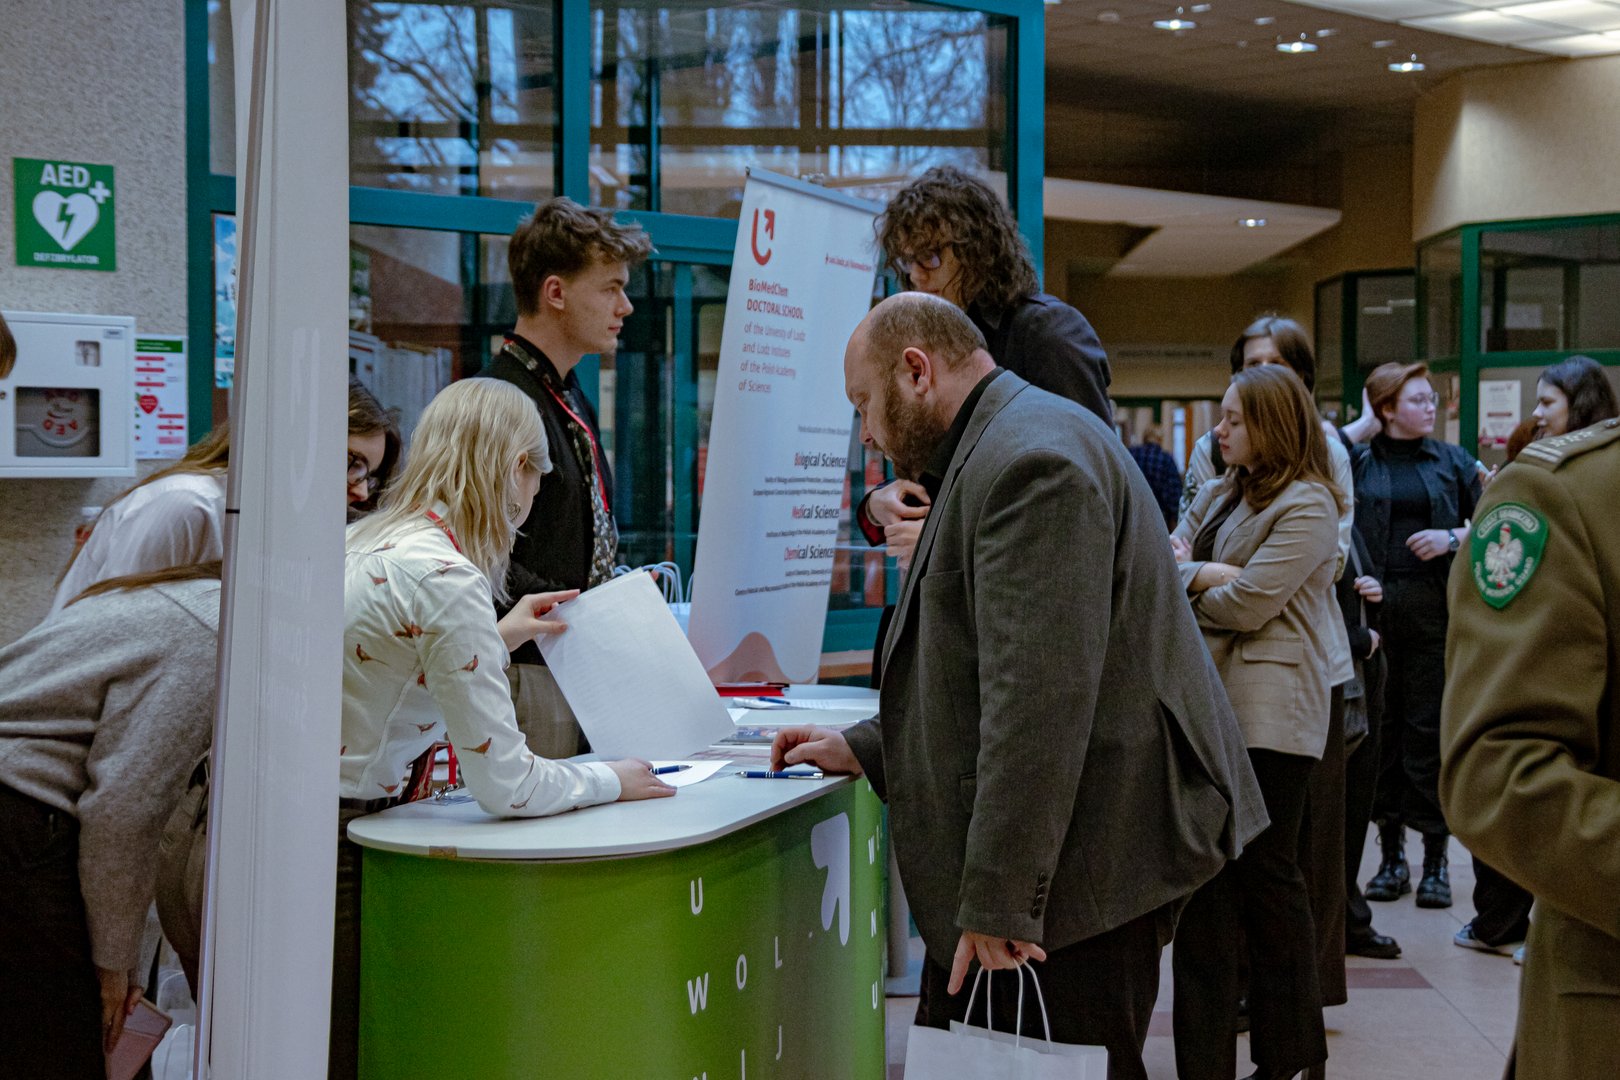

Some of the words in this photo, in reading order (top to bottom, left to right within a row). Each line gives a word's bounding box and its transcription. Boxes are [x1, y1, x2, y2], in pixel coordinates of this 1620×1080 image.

[41, 163, 90, 188] AED
[782, 304, 804, 320] SCHOOL
[744, 321, 752, 333] of
[753, 323, 764, 335] the
[742, 342, 756, 353] and
[740, 359, 749, 372] of
[750, 361, 760, 373] the
[738, 379, 747, 391] of
[690, 876, 703, 915] U
[687, 972, 709, 1015] W
